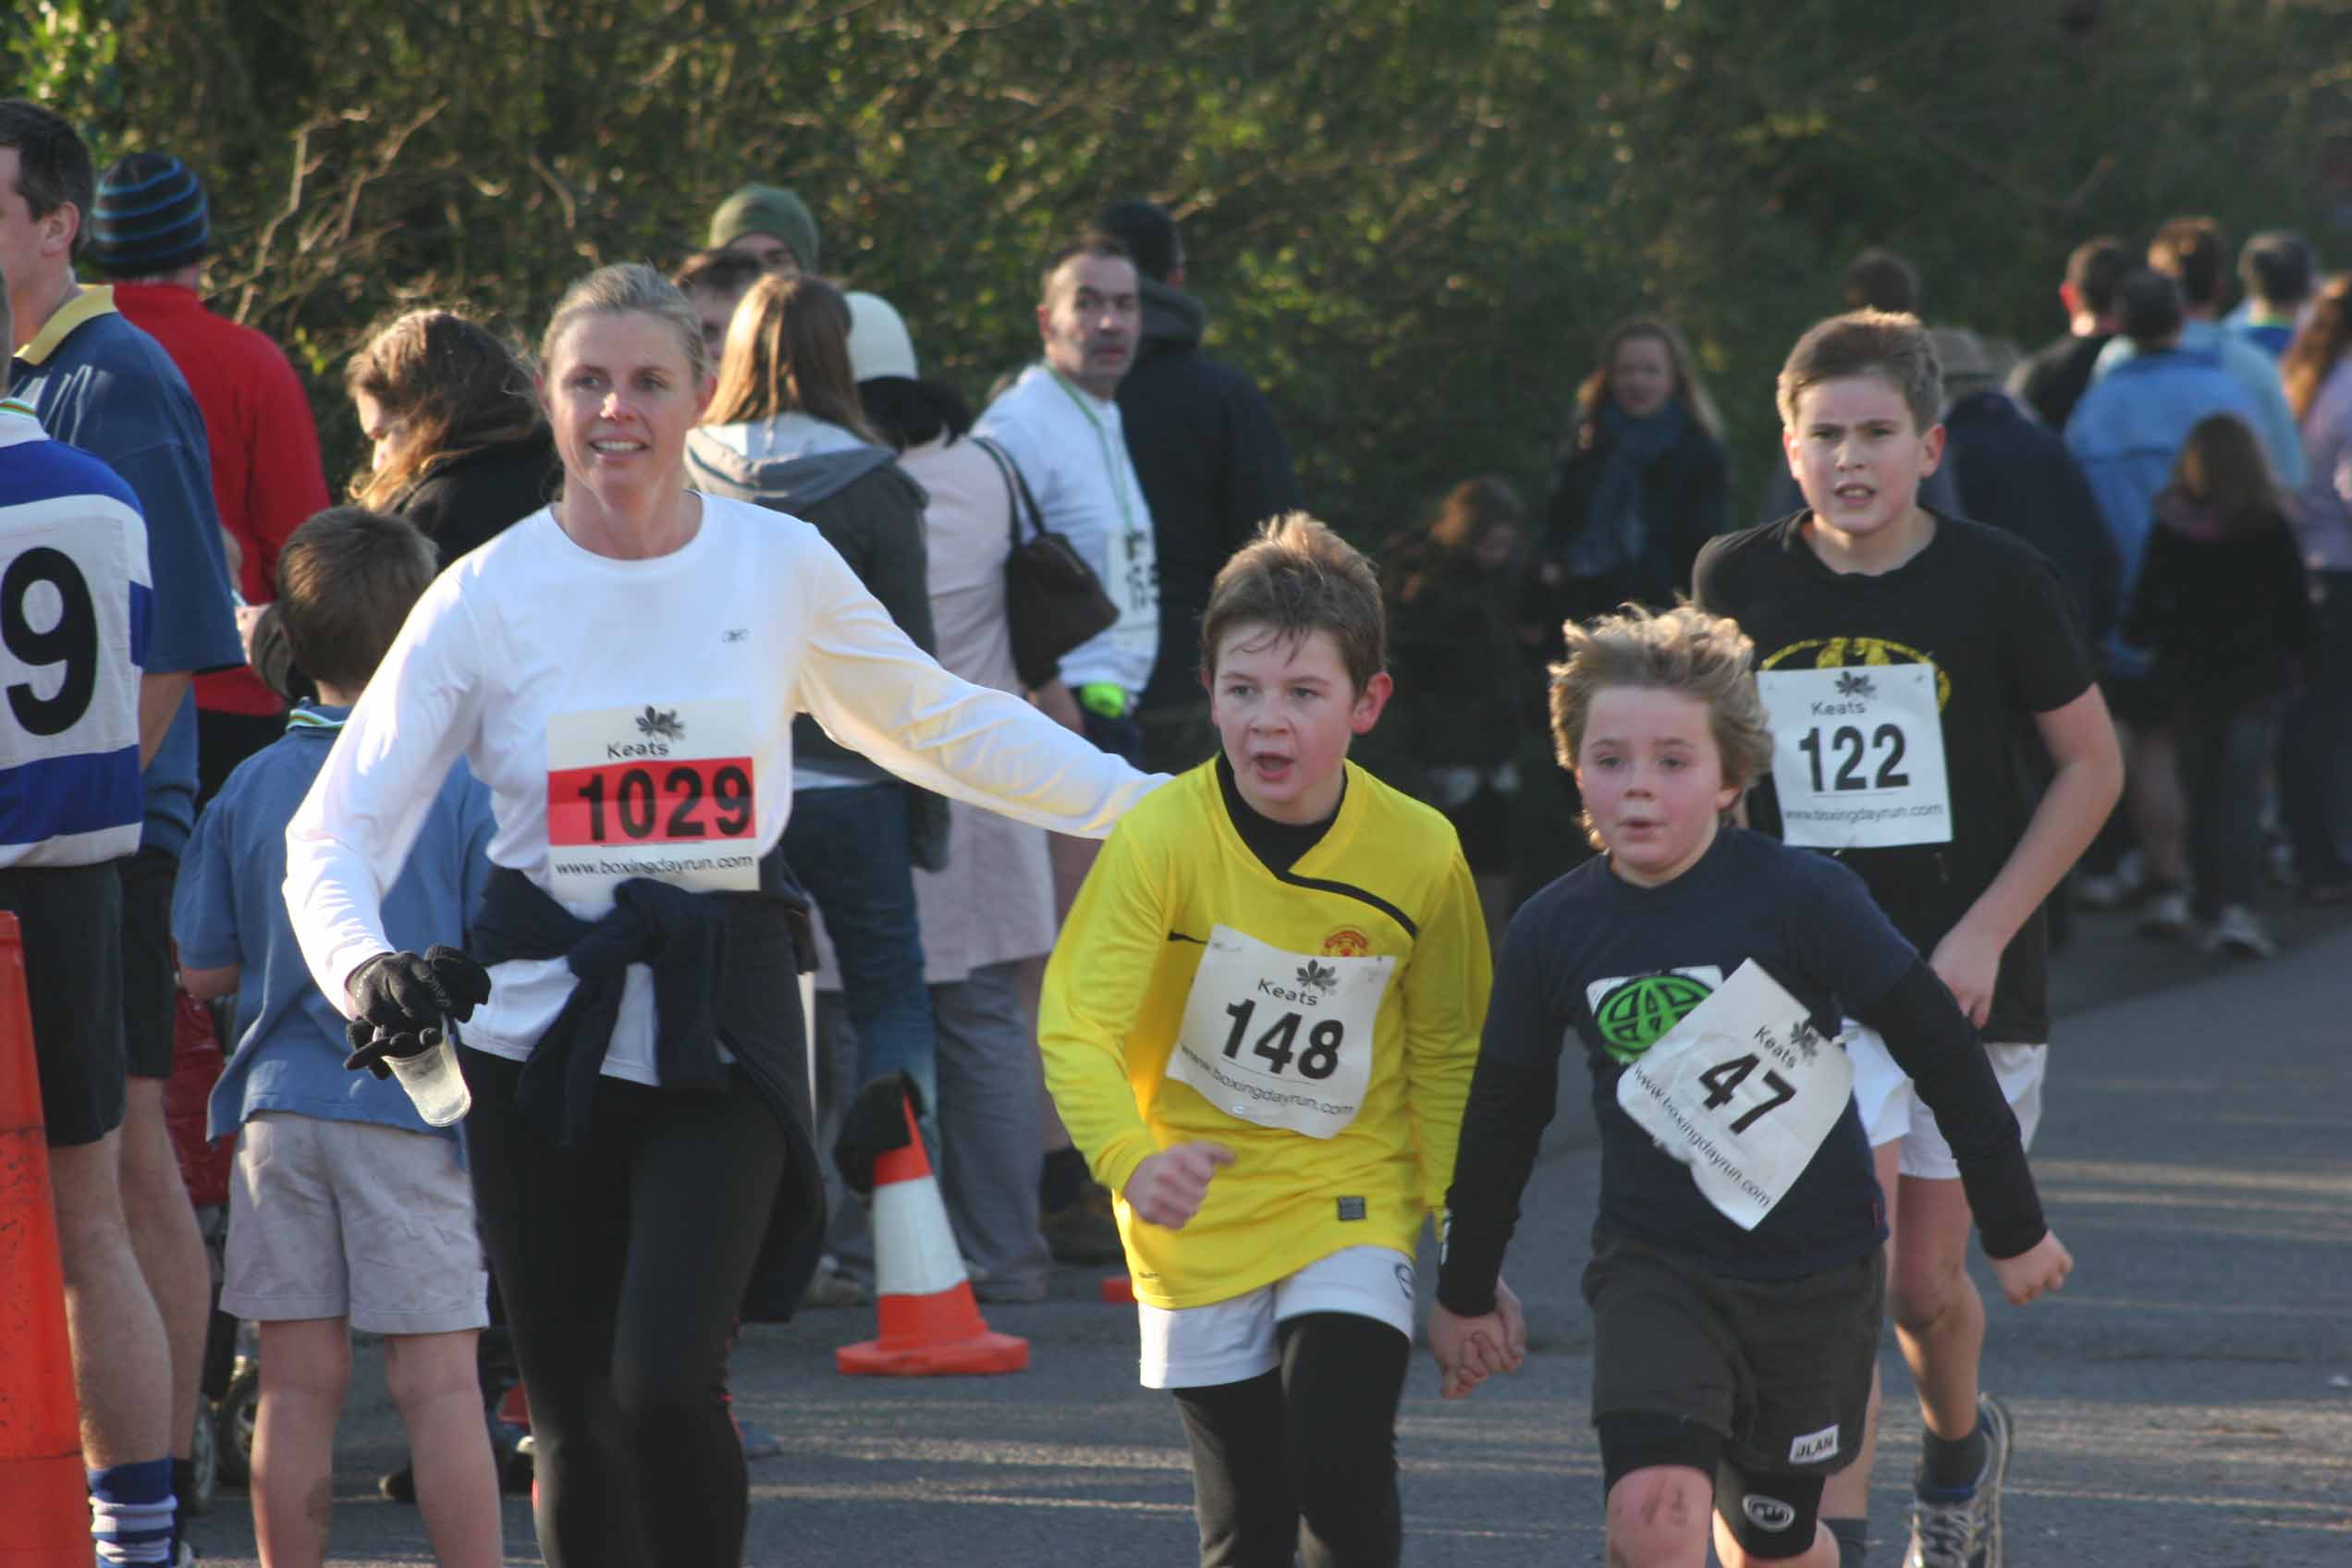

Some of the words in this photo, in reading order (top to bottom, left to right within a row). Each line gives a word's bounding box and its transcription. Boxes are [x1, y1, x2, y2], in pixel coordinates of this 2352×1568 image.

[1, 546, 98, 736] 9
[1811, 701, 1867, 717] Keats
[606, 741, 669, 759] Keats
[1798, 723, 1910, 792] 122
[578, 766, 753, 842] 1029
[1785, 803, 1942, 823] www.boxingdayrun.com
[555, 854, 754, 876] www.boxingdayrun.com
[1257, 977, 1318, 1007] Keats
[1222, 998, 1344, 1080] 148
[1753, 1024, 1797, 1070] Keats
[1180, 1042, 1354, 1115] www.boxingdayrun.com
[1698, 1052, 1797, 1135] 47
[1633, 1064, 1771, 1207] www.boxingdayrun.com
